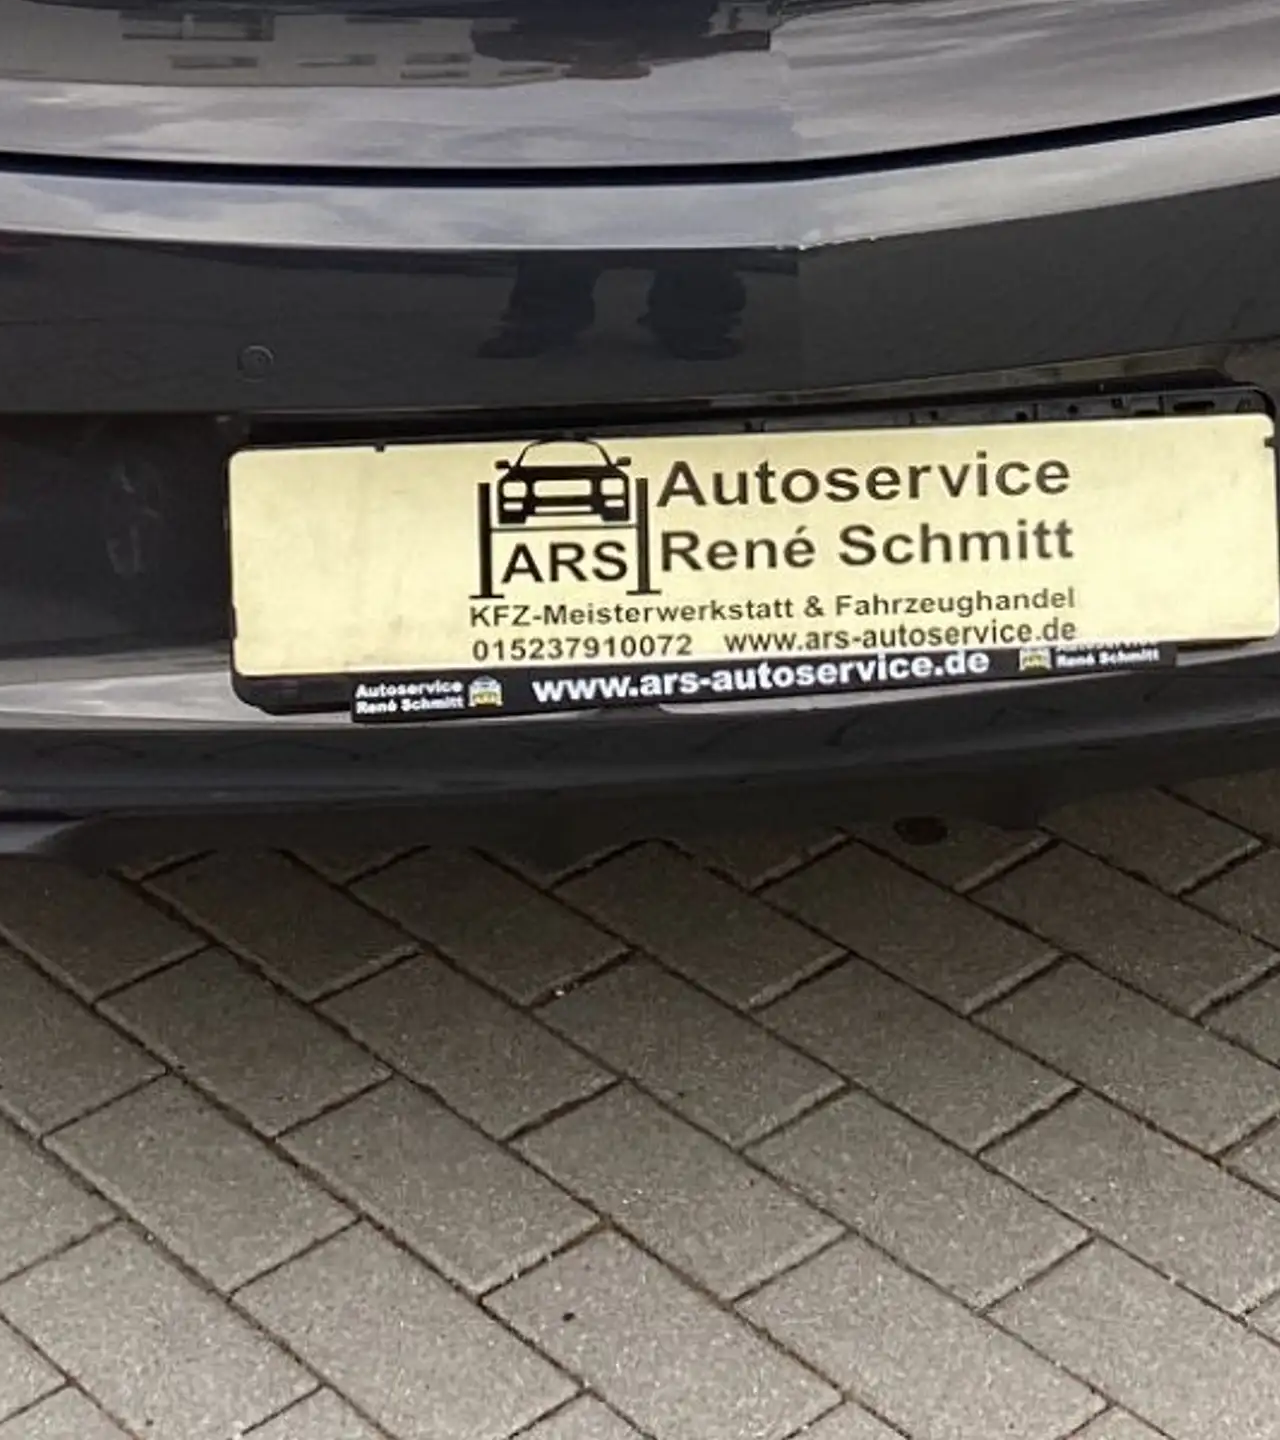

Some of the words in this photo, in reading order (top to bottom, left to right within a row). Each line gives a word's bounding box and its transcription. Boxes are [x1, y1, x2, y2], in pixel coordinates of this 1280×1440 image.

[656, 452, 1071, 508] Autoservice
[501, 540, 628, 585] ARS
[660, 528, 817, 573] René
[838, 518, 1074, 568] Schmitt
[470, 598, 794, 628] KFZ-Meisterwerkstatt
[807, 595, 826, 617] &
[836, 587, 1076, 620] Fahrzeughandel
[472, 634, 693, 662] 015237910072
[724, 618, 1077, 654] www.ars-autoservice.de
[356, 680, 463, 699] Autoservice
[532, 648, 990, 704] www.ars-autoservice.de
